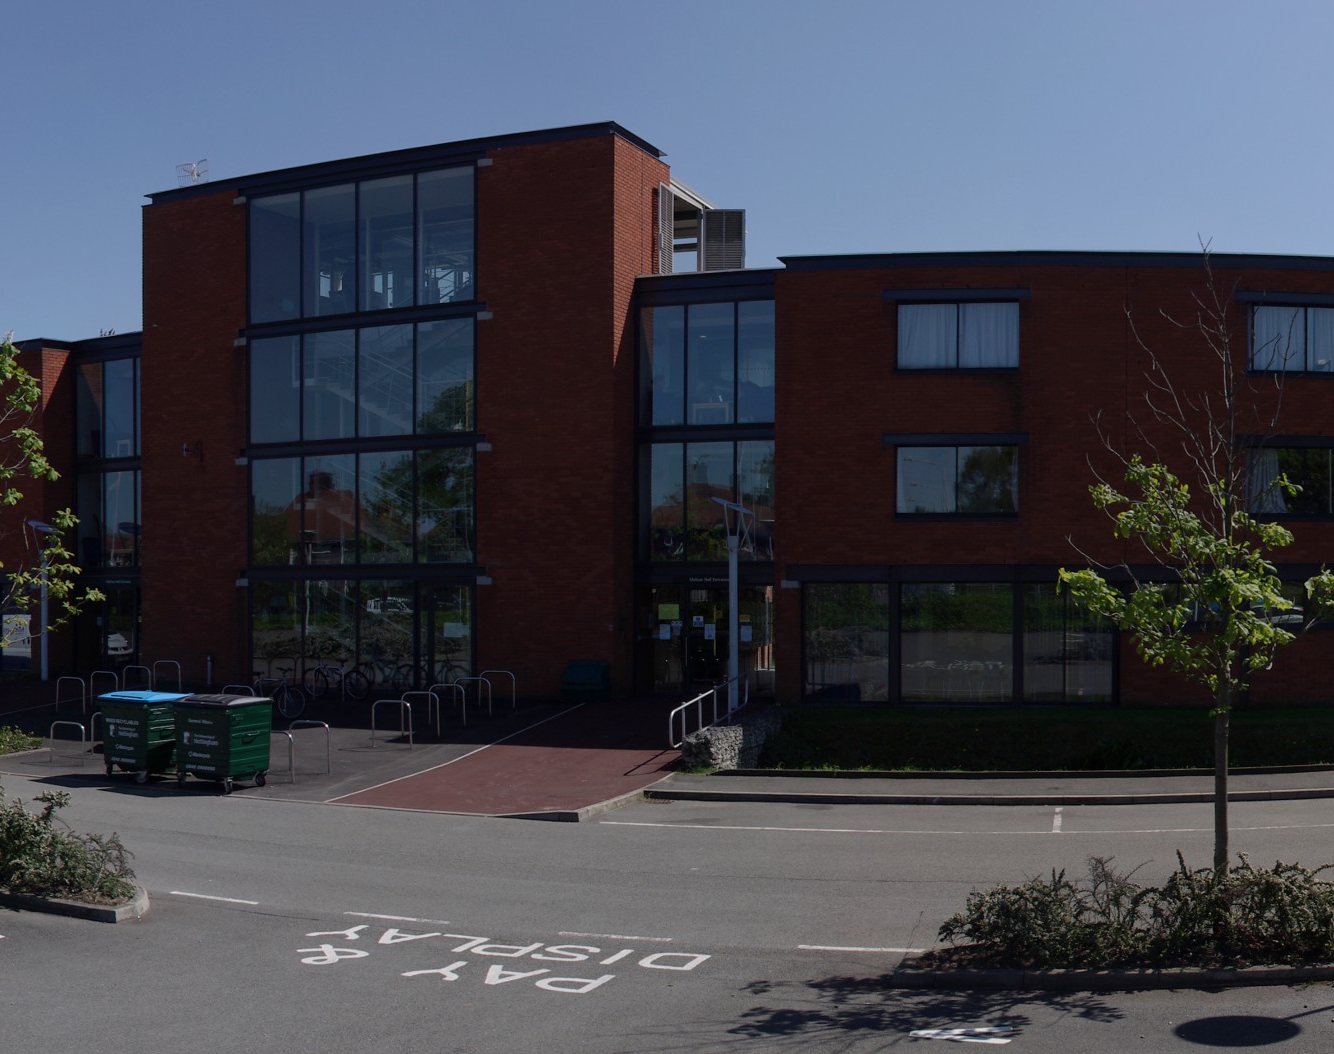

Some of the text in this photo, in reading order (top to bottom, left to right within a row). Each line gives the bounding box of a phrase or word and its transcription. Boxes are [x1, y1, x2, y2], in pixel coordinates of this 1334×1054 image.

[295, 943, 617, 994] PAY &
[305, 924, 712, 971] DISPLAY
